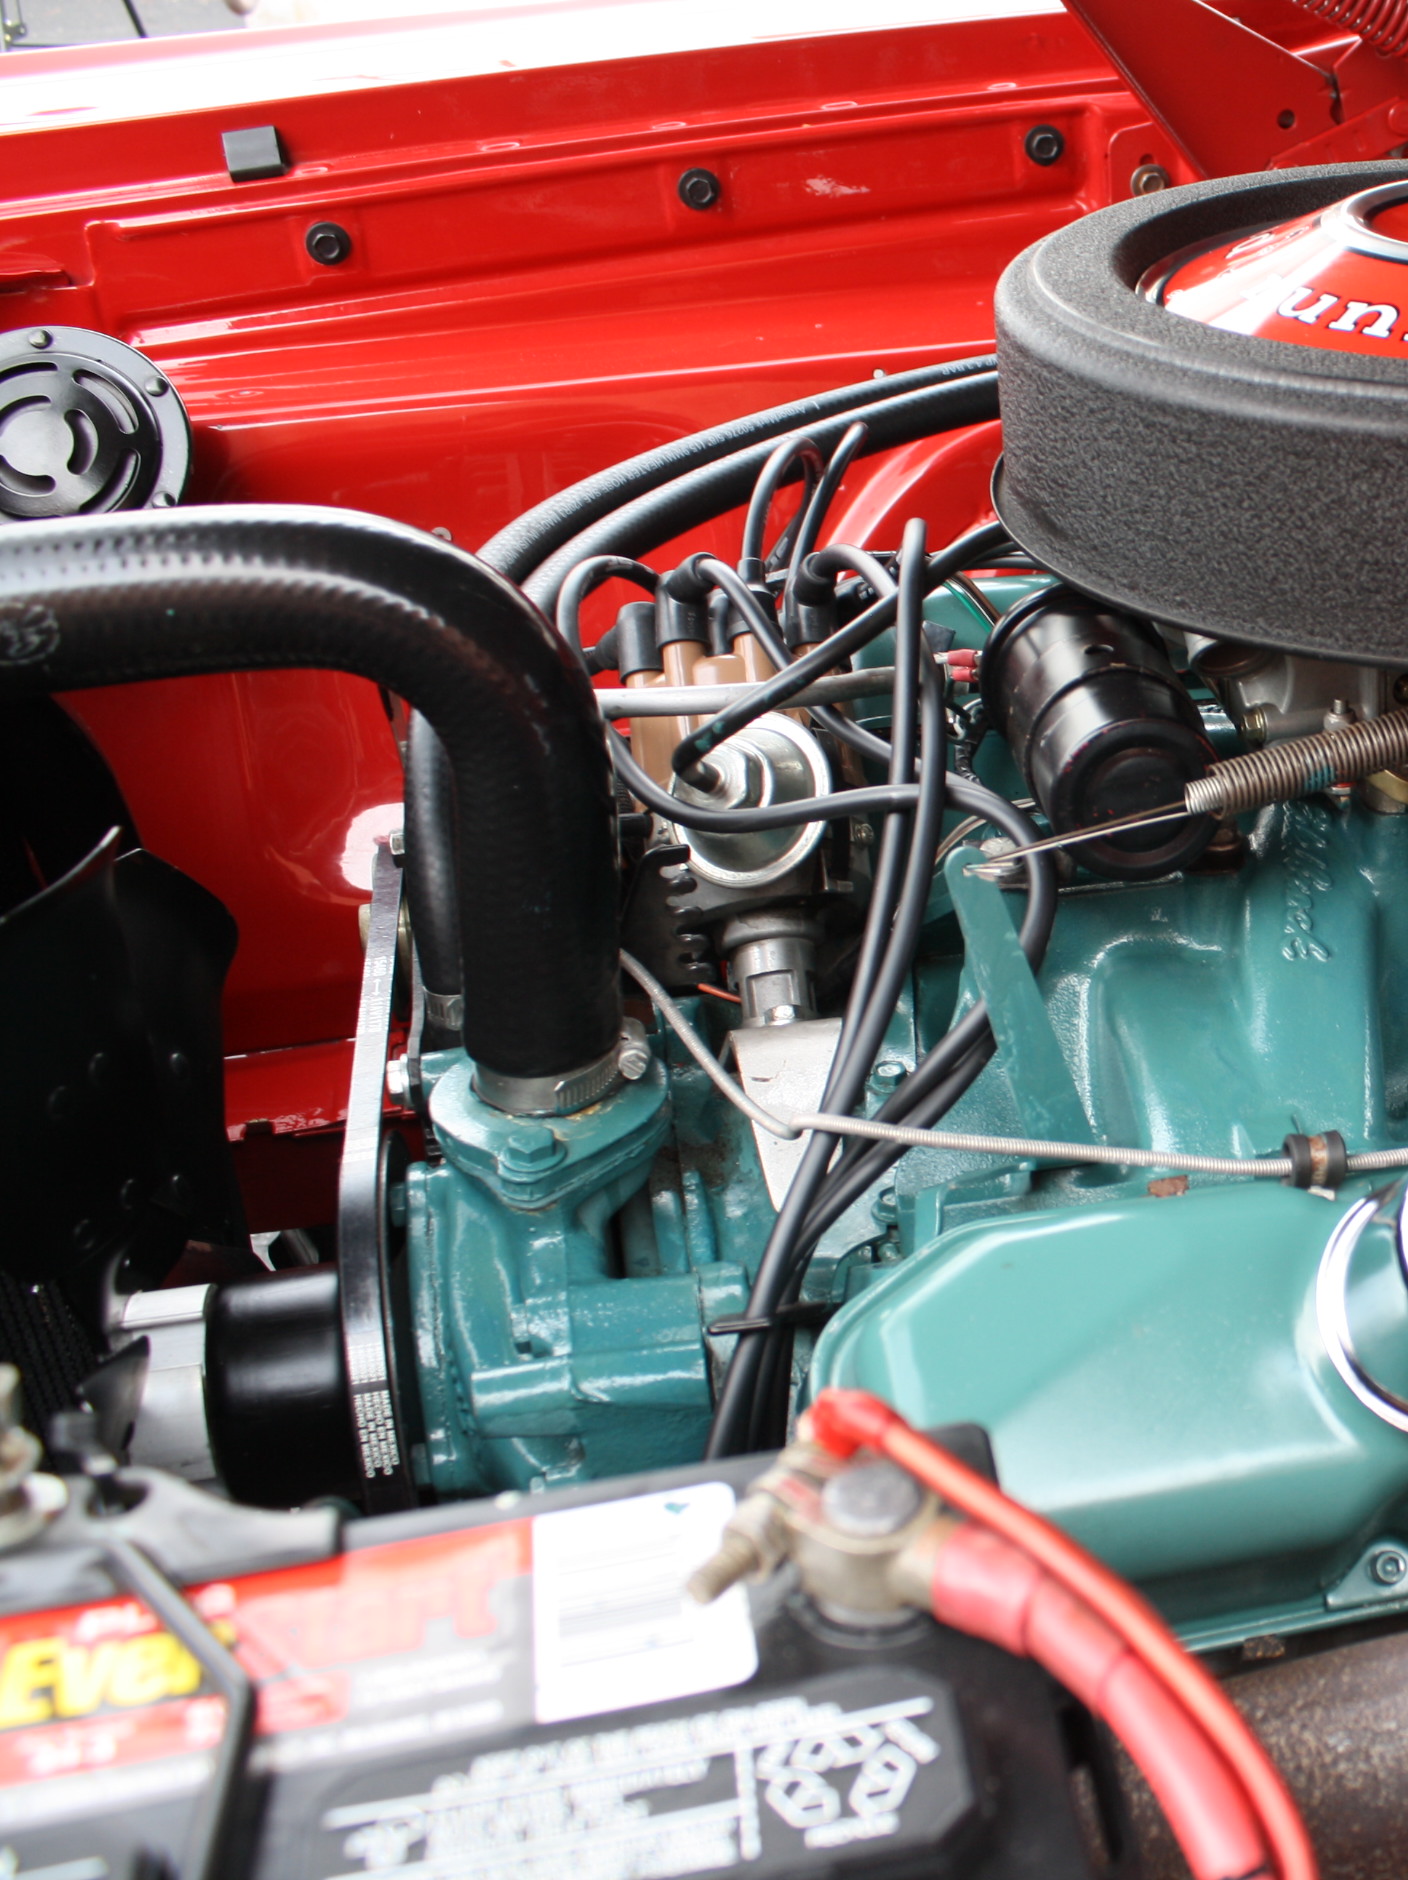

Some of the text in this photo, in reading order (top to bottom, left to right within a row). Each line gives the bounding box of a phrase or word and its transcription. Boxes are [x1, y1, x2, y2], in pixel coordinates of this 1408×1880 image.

[602, 472, 630, 494] HOSE
[629, 456, 665, 480] HEATER
[362, 1392, 374, 1420] MADE
[370, 1432, 382, 1468] MEXICO
[380, 1389, 393, 1418] MADE
[387, 1429, 400, 1466] MEXICO
[361, 1442, 376, 1478] MEXICO
[379, 1440, 393, 1475] MEXICO
